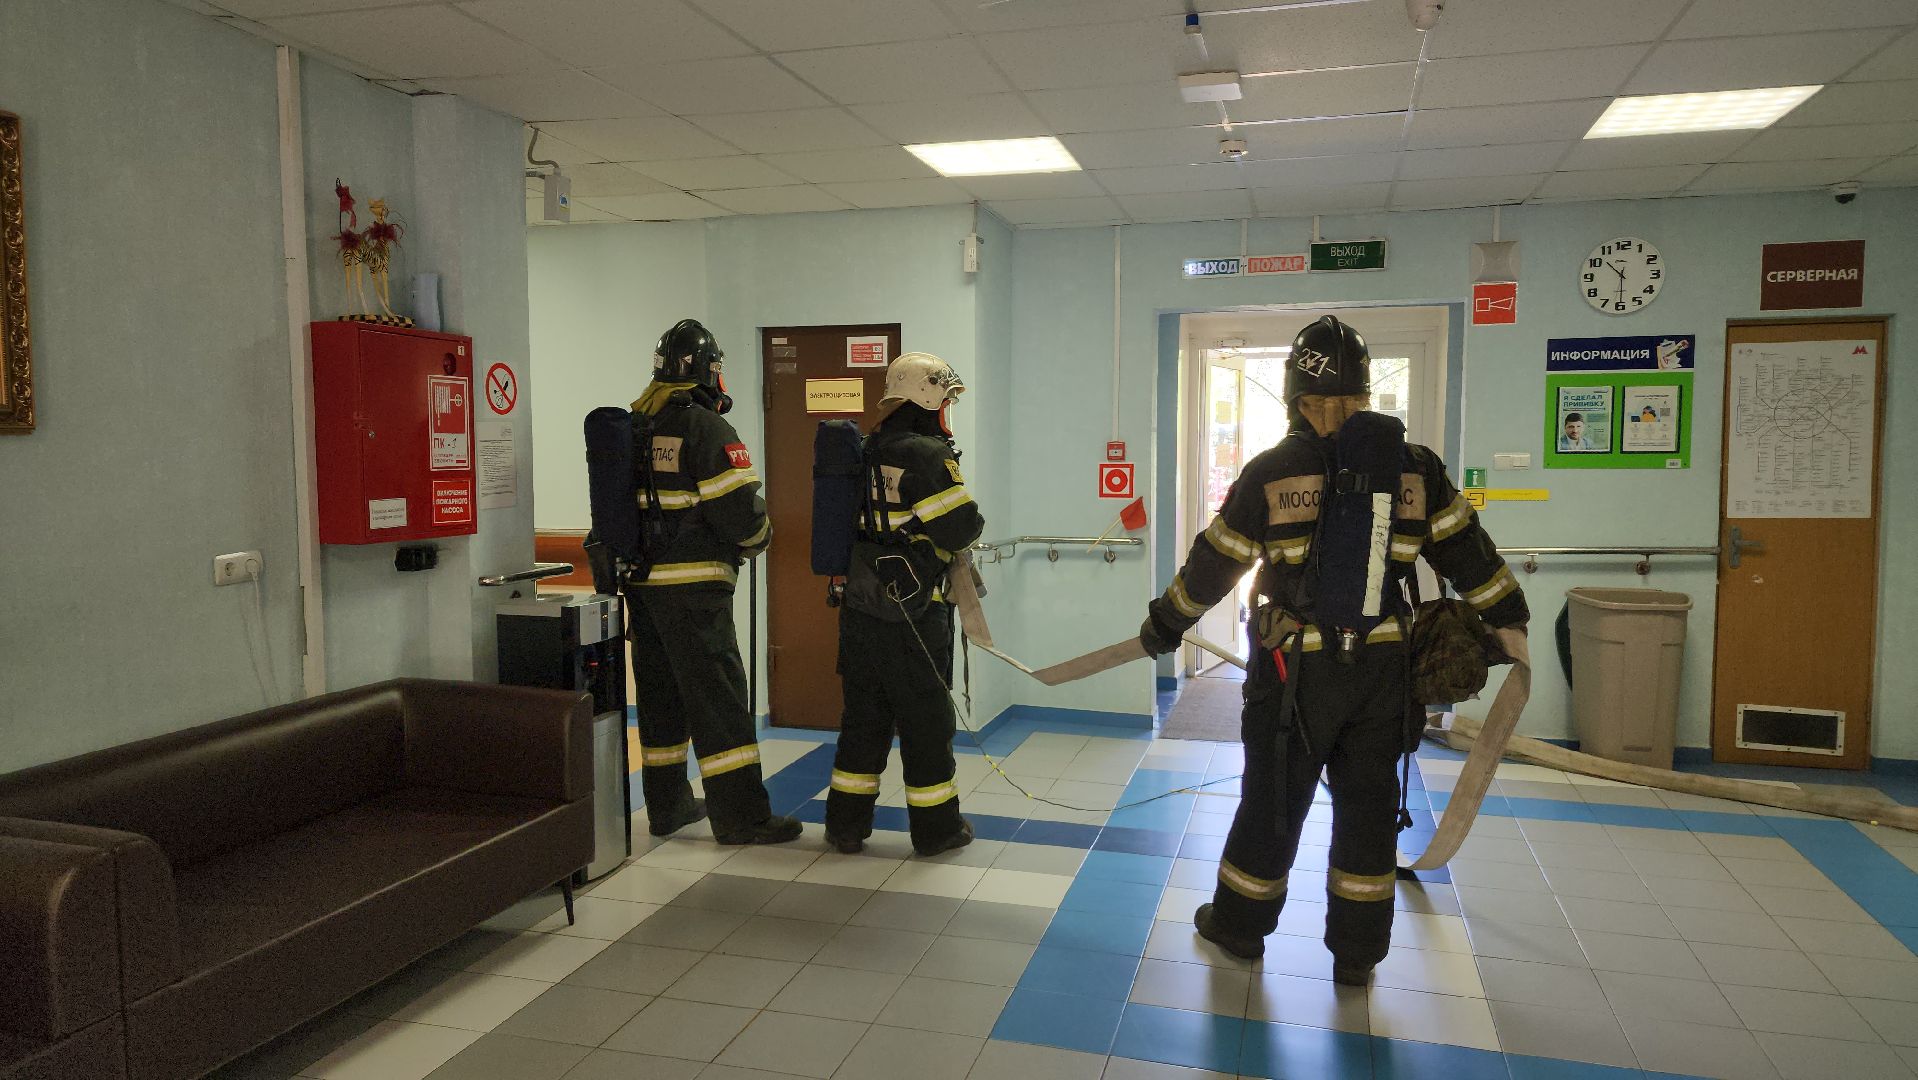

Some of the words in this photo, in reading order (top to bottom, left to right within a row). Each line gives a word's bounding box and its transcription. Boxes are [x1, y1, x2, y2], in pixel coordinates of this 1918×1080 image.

[1615, 241, 1631, 250] 12
[1637, 244, 1642, 252] 1
[1330, 245, 1365, 257] ВЫХОД
[1601, 246, 1611, 255] 11
[1251, 257, 1302, 271] ПОЖАР
[1338, 258, 1358, 267] EXIT
[1589, 258, 1602, 268] 10
[1647, 255, 1657, 264] 2
[1188, 261, 1237, 275] ВЫХОД
[1584, 273, 1594, 282] 9
[1650, 270, 1660, 279] 3
[1766, 268, 1858, 283] СЕРВЕРНАЯ
[1588, 288, 1597, 297] 8
[1643, 285, 1654, 294] 4
[1600, 299, 1609, 308] 7
[1632, 297, 1642, 306] 5
[1615, 302, 1625, 311] 6
[1551, 349, 1650, 362] ИНФОРМАЦИЯ
